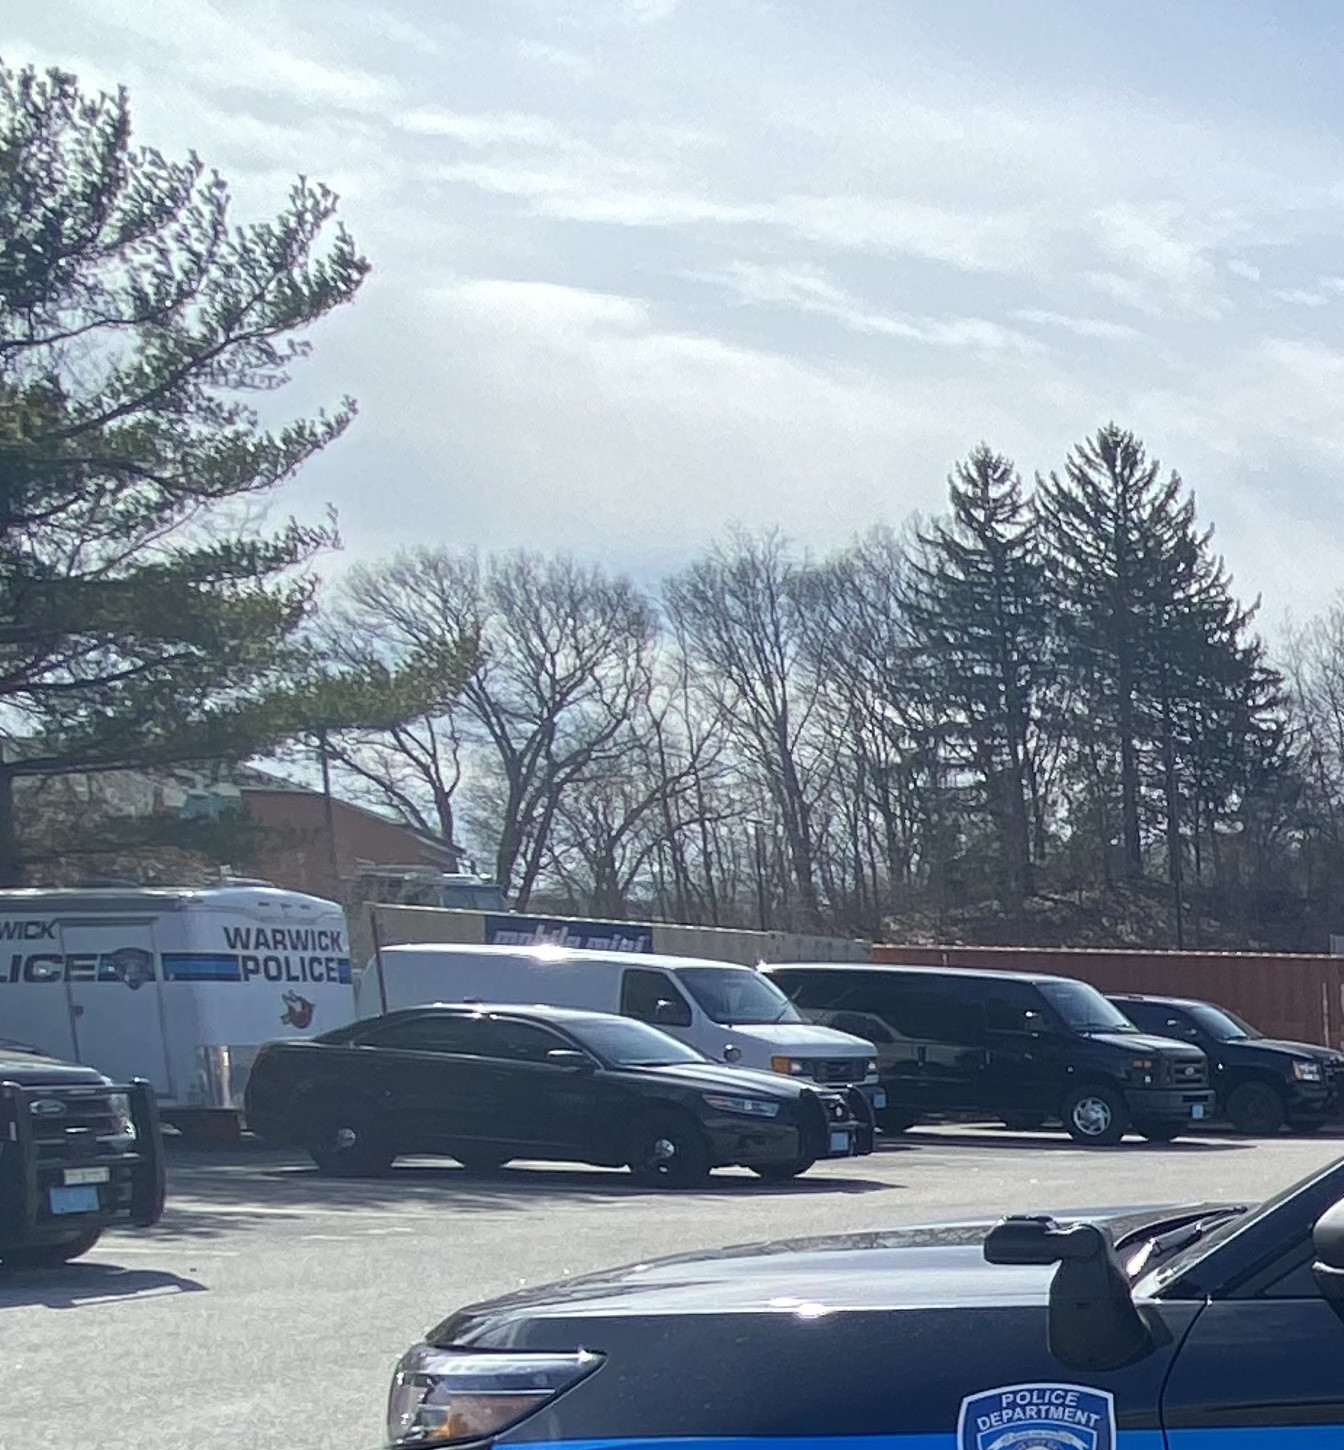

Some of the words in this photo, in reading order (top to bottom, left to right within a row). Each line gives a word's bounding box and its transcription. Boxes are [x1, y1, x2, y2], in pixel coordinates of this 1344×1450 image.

[223, 926, 343, 952] WARWICK
[241, 955, 338, 982] POLICE
[1001, 1390, 1080, 1407] POLICE
[976, 1404, 1100, 1430] DEPARTMENT
